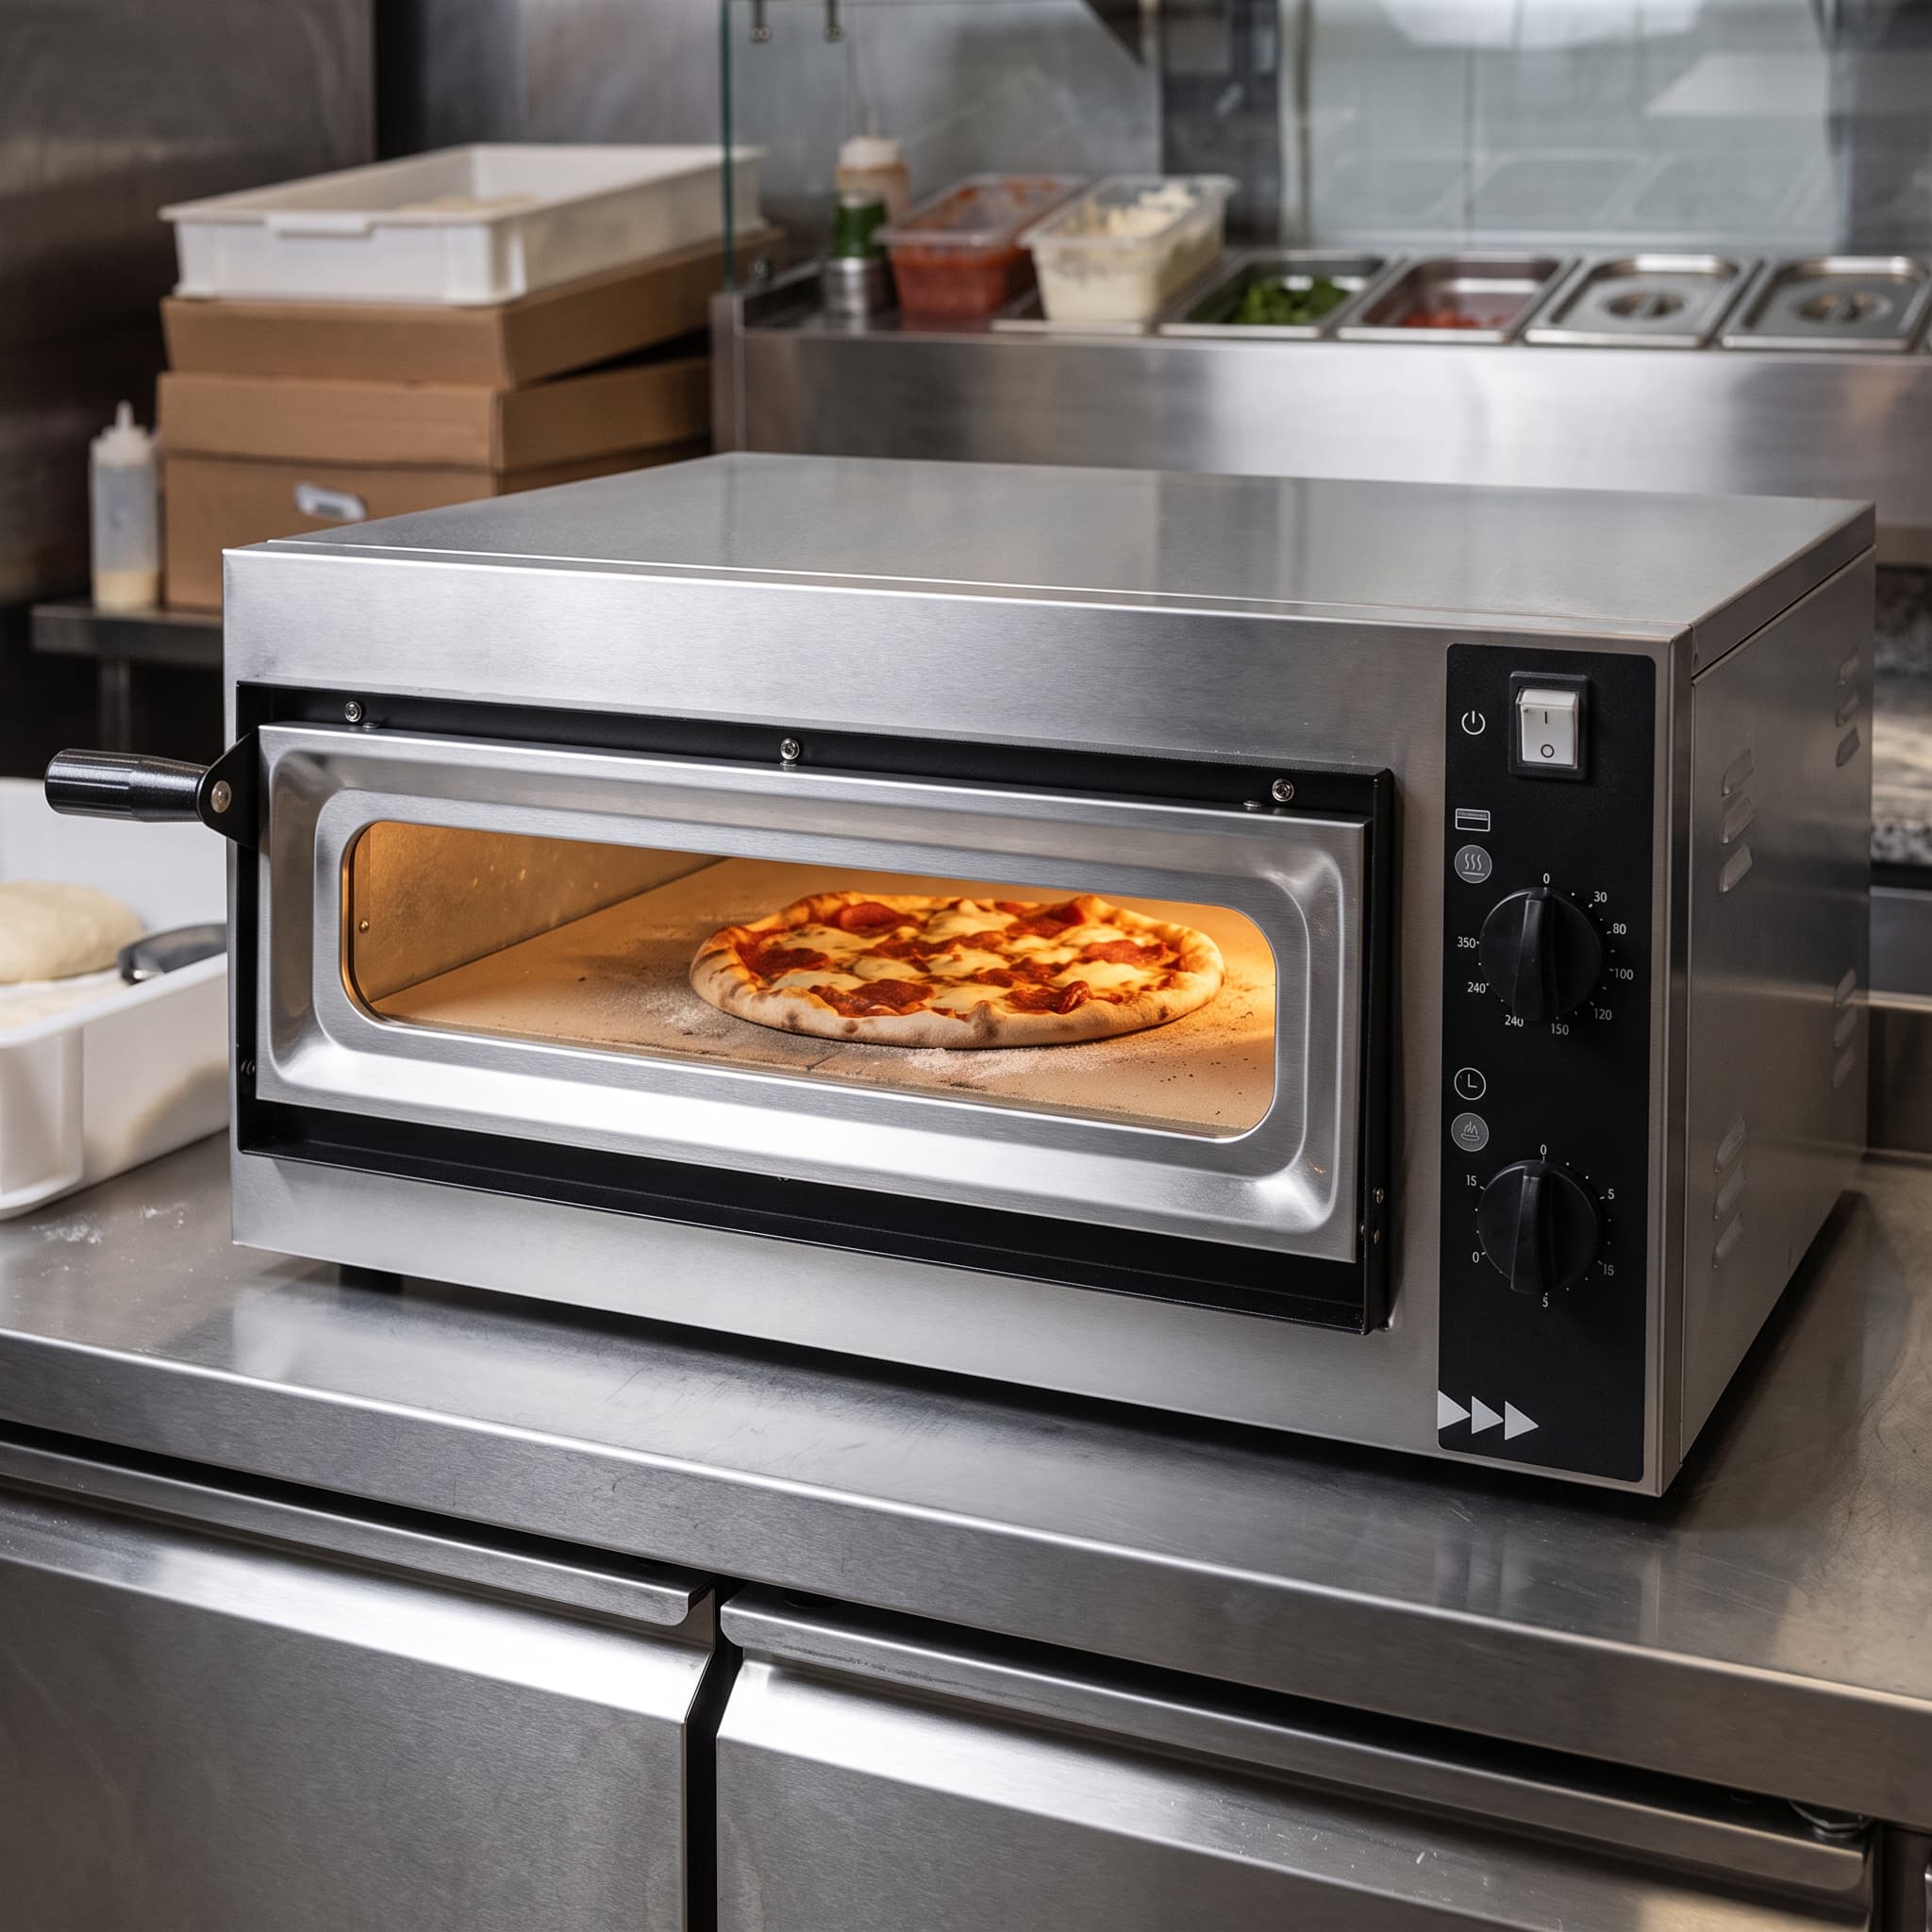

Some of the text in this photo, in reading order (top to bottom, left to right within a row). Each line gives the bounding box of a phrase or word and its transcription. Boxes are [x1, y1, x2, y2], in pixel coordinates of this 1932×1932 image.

[1542, 873, 1550, 884] 0
[1593, 891, 1607, 903] 30
[1612, 923, 1627, 935] 80
[1457, 936, 1476, 949] 350
[1614, 968, 1634, 980] 100
[1467, 981, 1486, 993] 240
[1593, 1008, 1612, 1021] 120
[1551, 1023, 1570, 1035] 150
[1540, 1144, 1547, 1156] 0
[1467, 1174, 1477, 1187] 15
[1607, 1189, 1615, 1200] 5
[1472, 1252, 1479, 1263] 0
